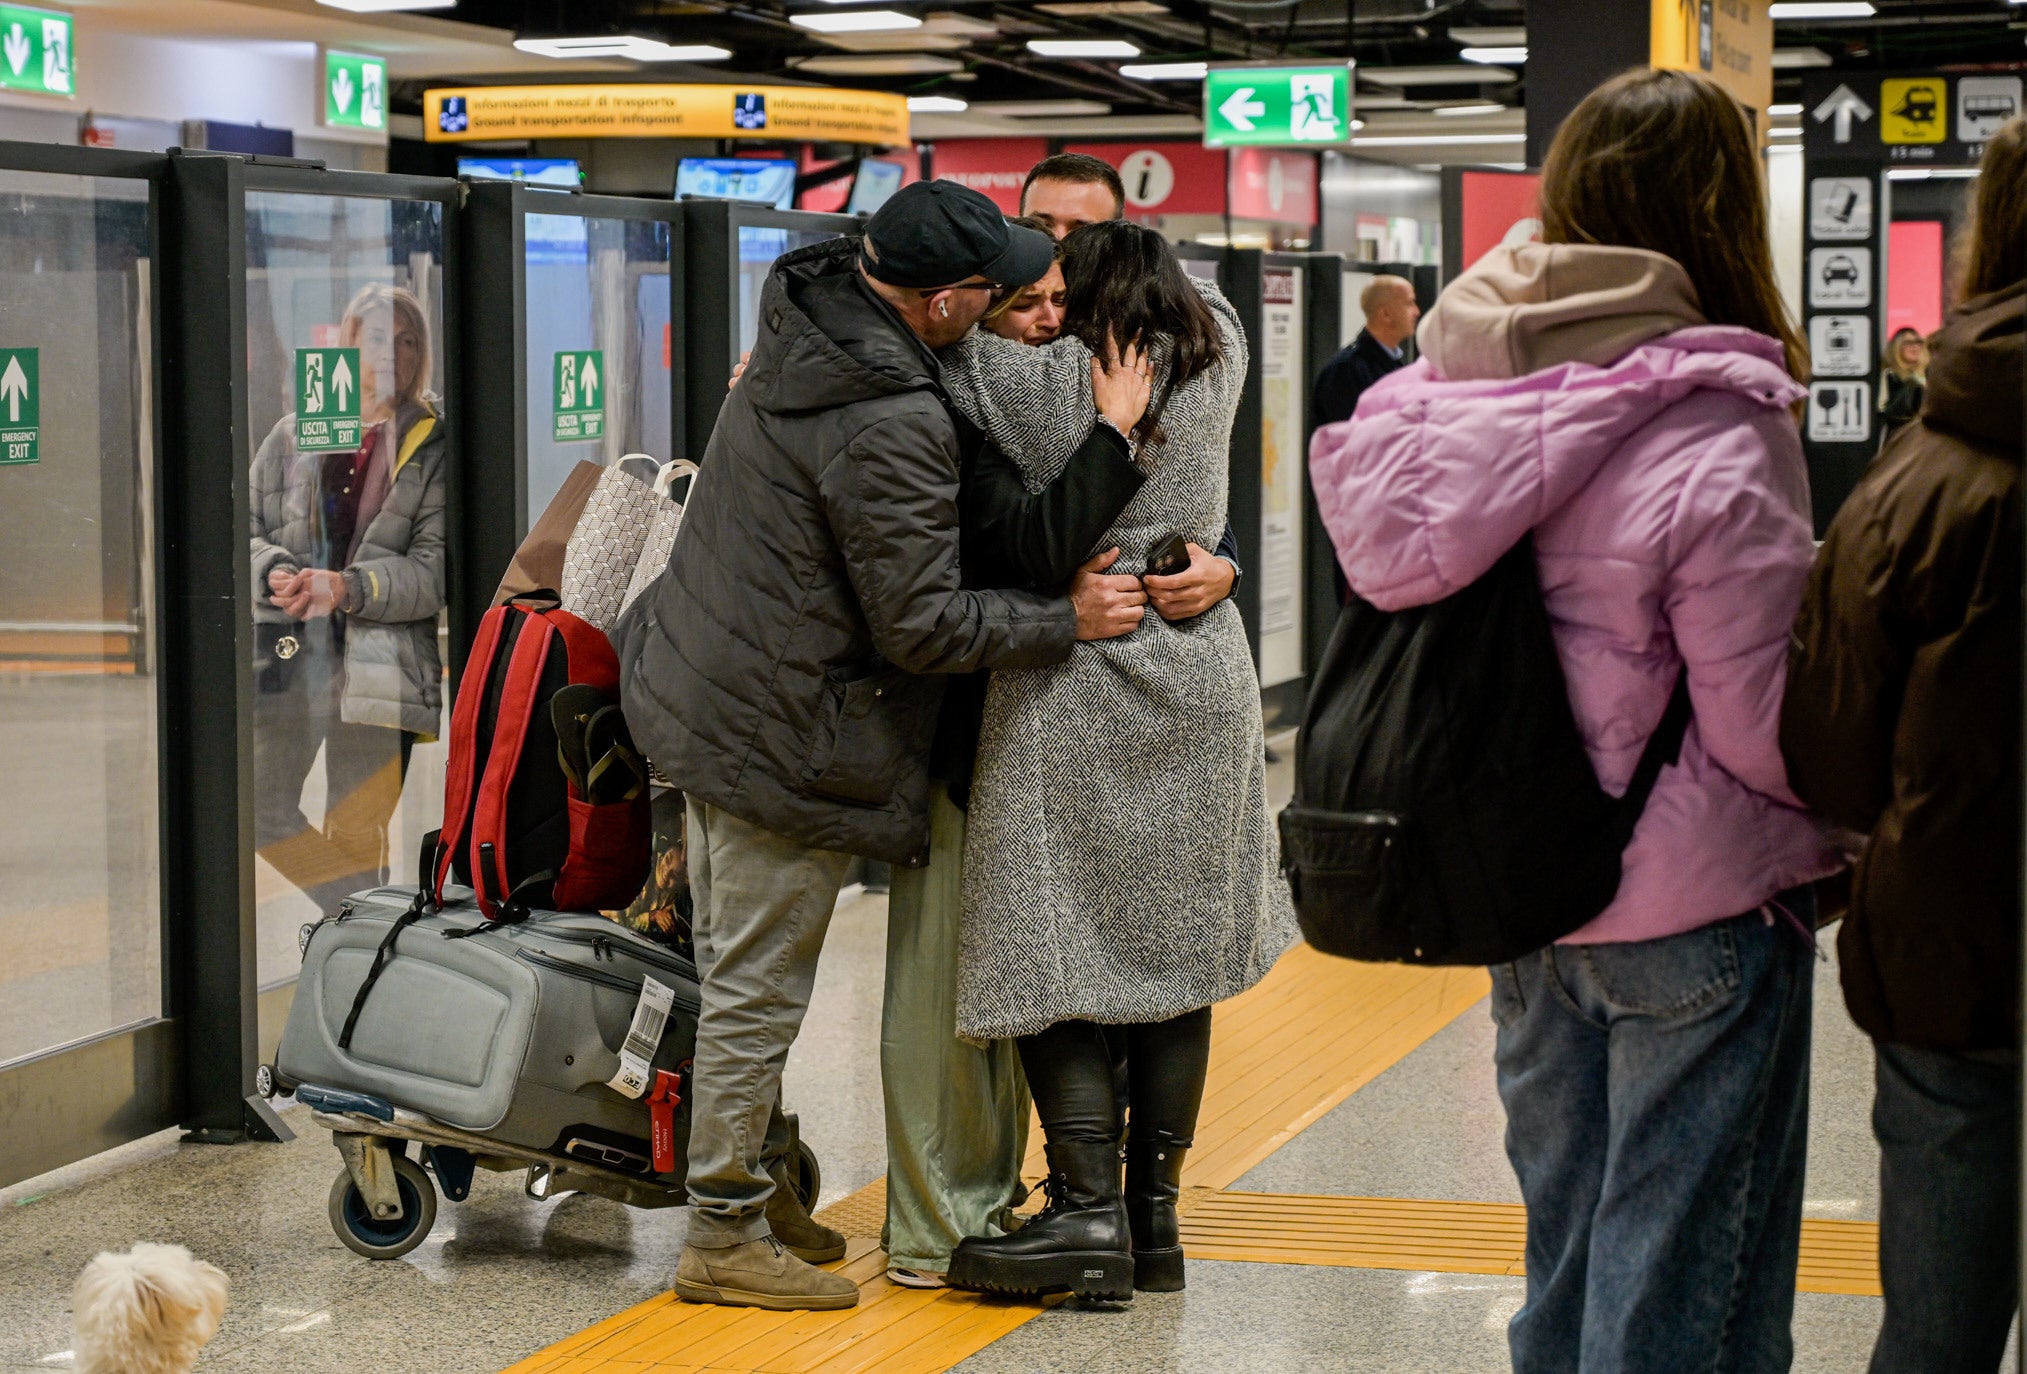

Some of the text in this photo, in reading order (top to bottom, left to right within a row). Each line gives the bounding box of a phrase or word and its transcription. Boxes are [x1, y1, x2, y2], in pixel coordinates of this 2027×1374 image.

[473, 97, 549, 109] Informazioni
[612, 95, 676, 109] trasporto
[473, 114, 517, 128] Ground
[520, 113, 616, 127] transportation
[302, 421, 328, 435] USCITA
[332, 420, 359, 429] EMERGENCY
[1, 431, 37, 443] EMERGENCY
[338, 429, 354, 444] EXIT
[9, 443, 30, 459] EXIT
[623, 1074, 641, 1091] FCO
